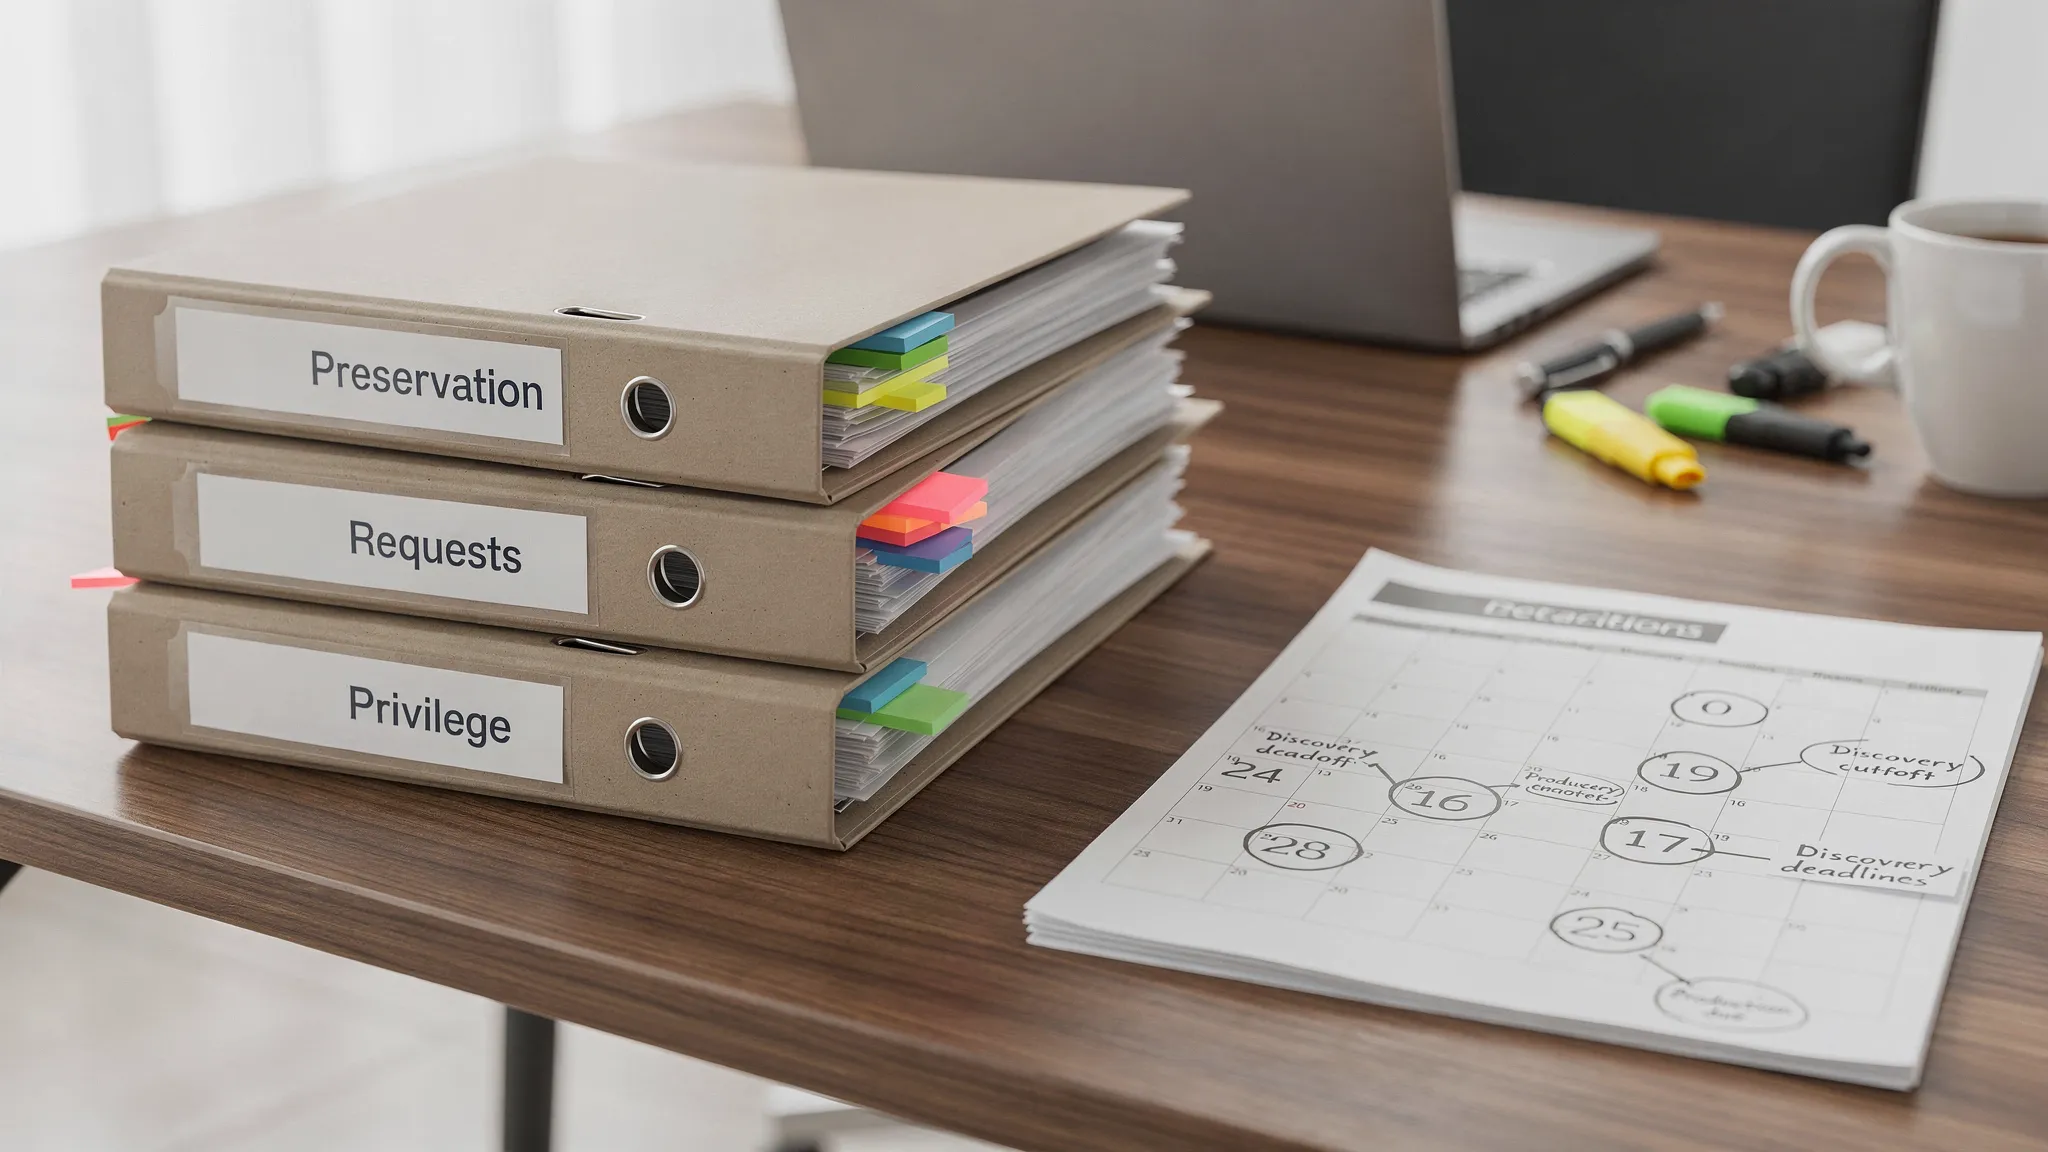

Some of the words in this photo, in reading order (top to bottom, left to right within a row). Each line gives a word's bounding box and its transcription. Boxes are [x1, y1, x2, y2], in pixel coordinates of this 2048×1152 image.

[312, 350, 544, 411] Preservation
[350, 520, 523, 574] Requests
[350, 685, 512, 749] Privilege
[1266, 731, 1379, 760] Discovery
[1829, 744, 1964, 773] Discovery
[1221, 761, 1284, 784] 24
[1659, 762, 1719, 782] 19
[1411, 790, 1473, 812] 16
[1260, 836, 1331, 860] 28
[1625, 830, 1690, 853] 17
[1569, 916, 1640, 942] 25
